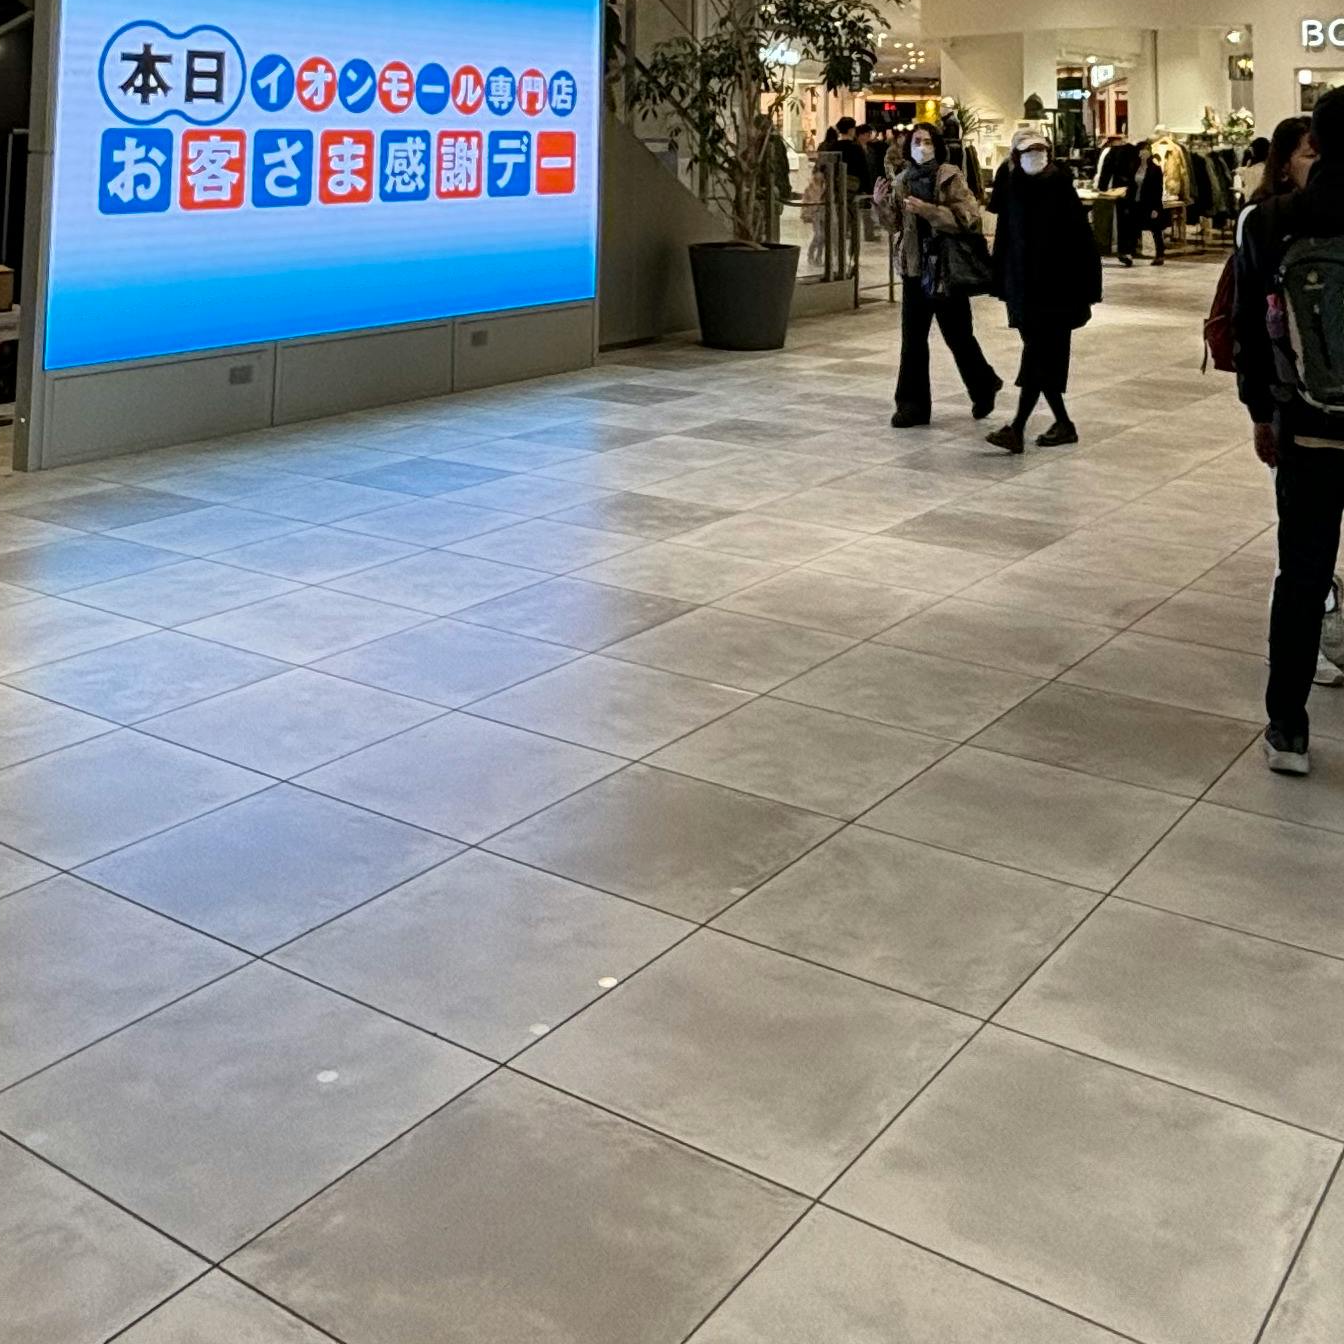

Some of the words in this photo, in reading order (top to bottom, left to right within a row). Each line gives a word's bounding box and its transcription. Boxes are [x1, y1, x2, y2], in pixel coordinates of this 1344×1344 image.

[118, 43, 226, 104] 本日
[255, 61, 575, 109] イオンモール専門店
[107, 136, 571, 201] お客さま感謝デー
